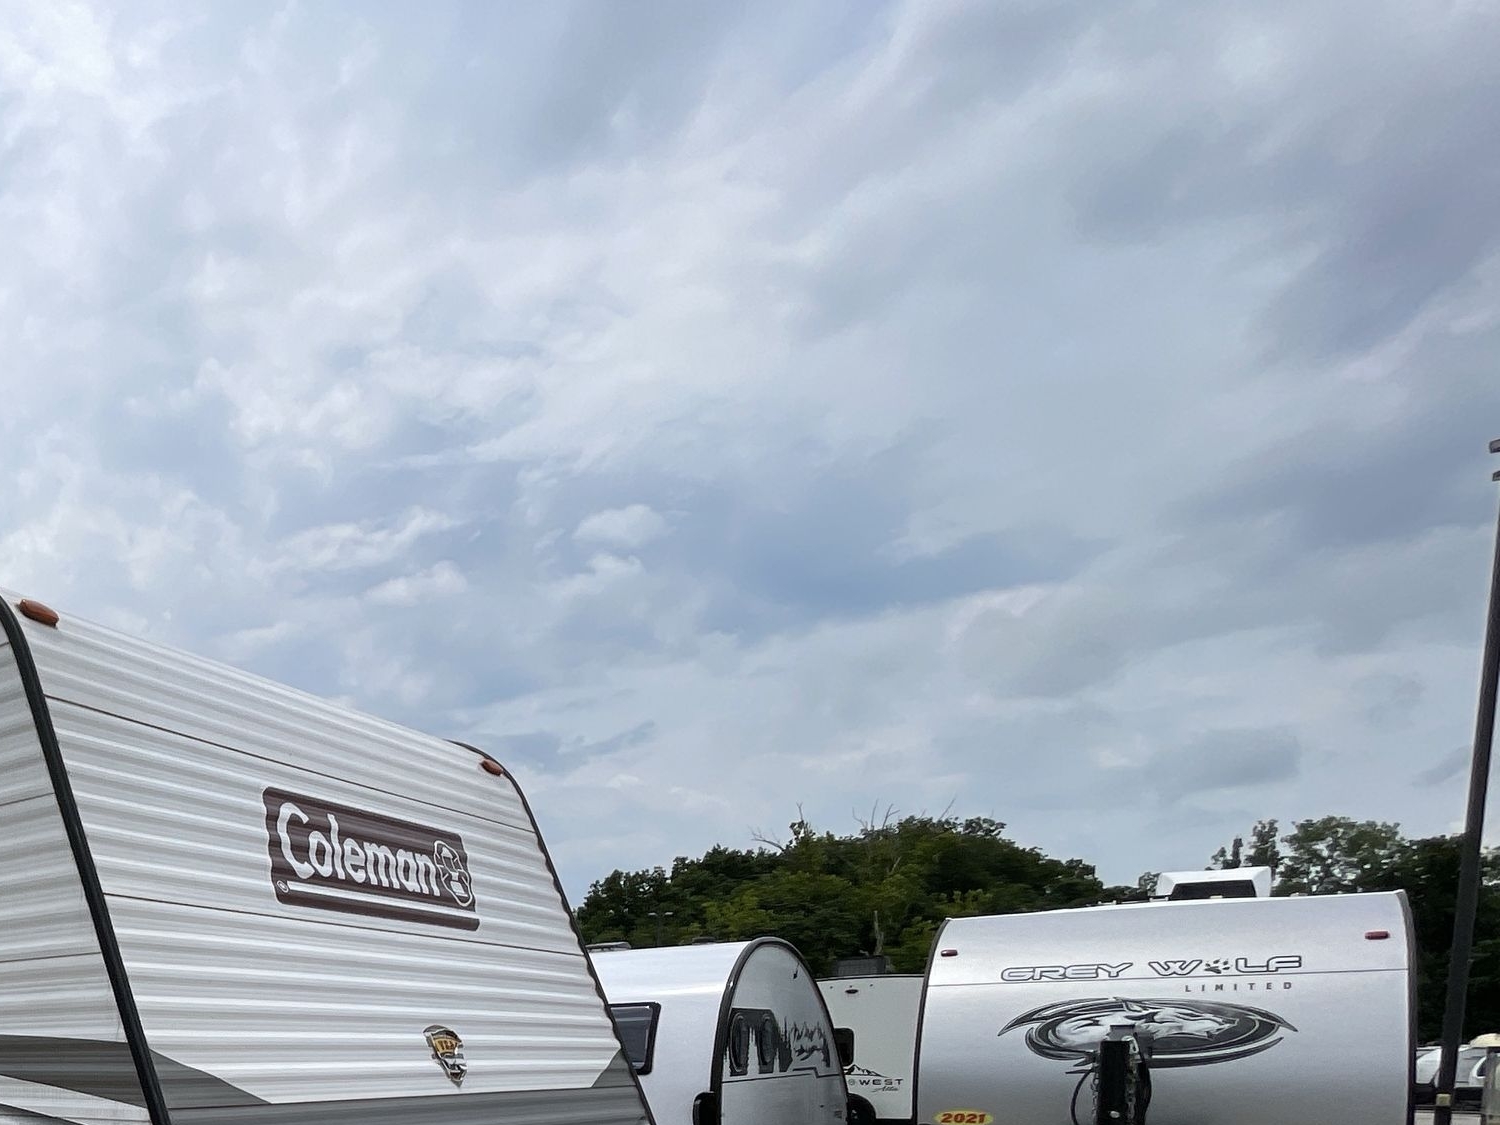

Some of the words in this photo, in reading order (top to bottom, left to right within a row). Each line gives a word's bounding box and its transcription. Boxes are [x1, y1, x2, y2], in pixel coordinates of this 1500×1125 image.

[277, 802, 441, 897] Coleman
[1000, 962, 1133, 982] GREY
[1184, 982, 1292, 993] LIMITED
[859, 1078, 904, 1086] WEST
[940, 1112, 987, 1124] 2021
